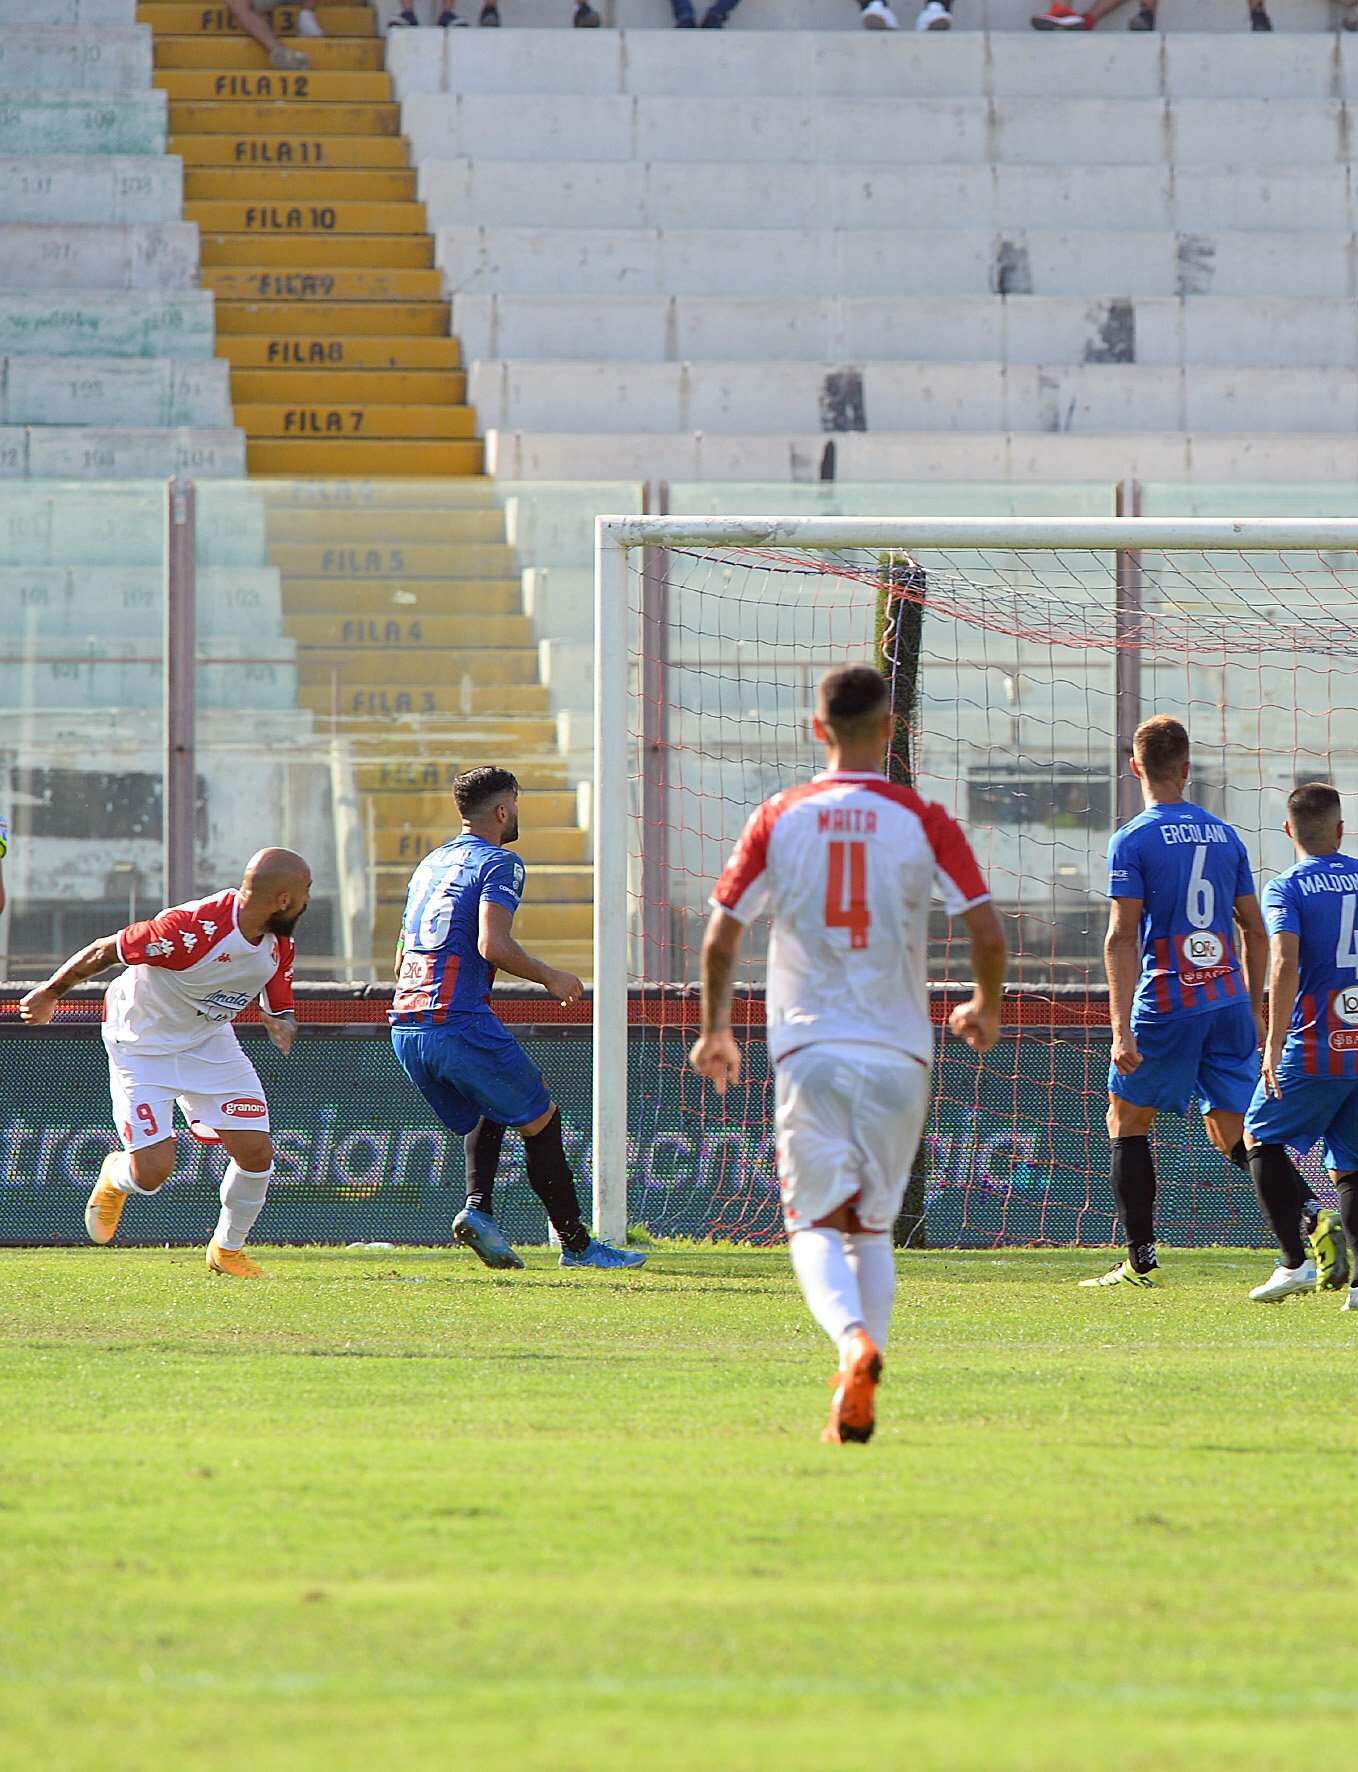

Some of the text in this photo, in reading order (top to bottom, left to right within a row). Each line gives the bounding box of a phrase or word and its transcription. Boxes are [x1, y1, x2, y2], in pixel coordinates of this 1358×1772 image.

[214, 76, 310, 97] FILA 12
[235, 141, 323, 162] FILA 11
[244, 207, 335, 229] FILA 10
[284, 411, 364, 431] FILA 7
[322, 549, 405, 571] FILA 5
[341, 620, 423, 642] FILA 4
[352, 690, 437, 713] FILA 3
[817, 809, 877, 834] MAITA
[1159, 823, 1228, 845] ERCOLANI
[825, 842, 871, 949] 4
[1186, 845, 1215, 929] 6
[225, 1101, 266, 1116] granoro
[136, 1103, 159, 1137] 9
